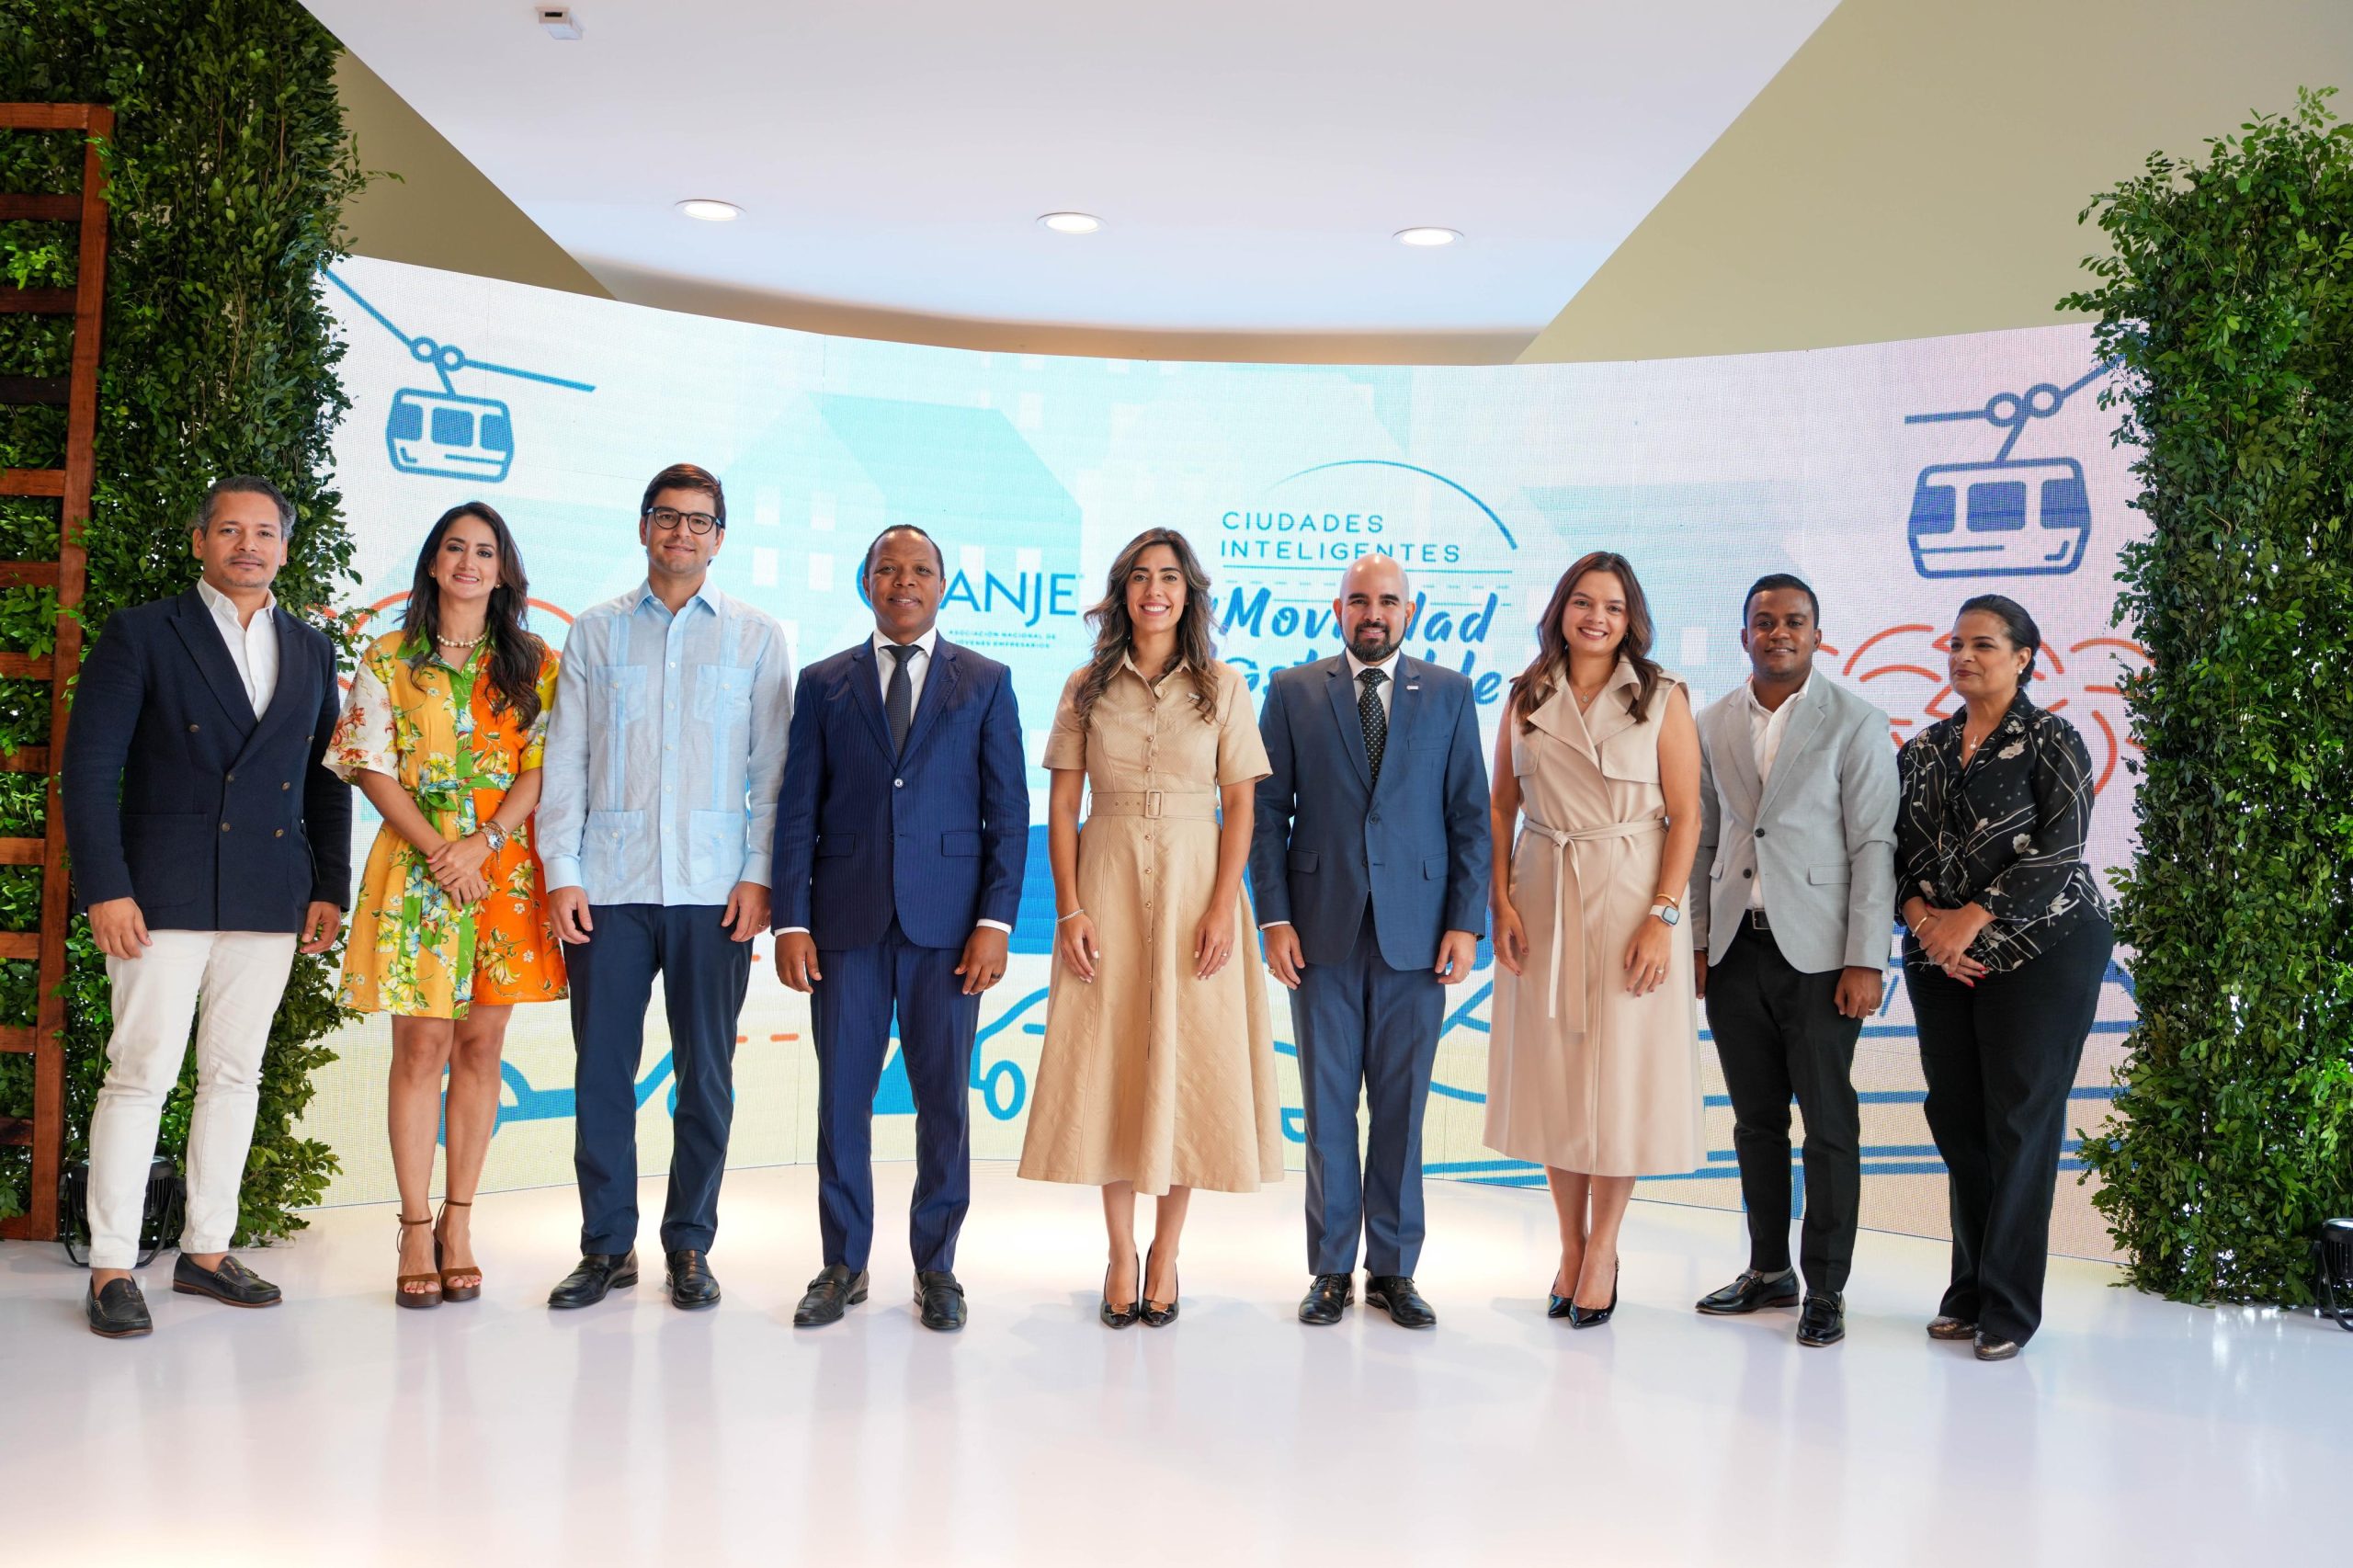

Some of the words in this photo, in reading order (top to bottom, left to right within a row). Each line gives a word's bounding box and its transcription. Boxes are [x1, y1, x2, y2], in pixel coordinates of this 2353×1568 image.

[1222, 511, 1384, 533] CIUDADES
[1221, 540, 1461, 562] INTELIGENTES
[938, 568, 1077, 628] ANJE
